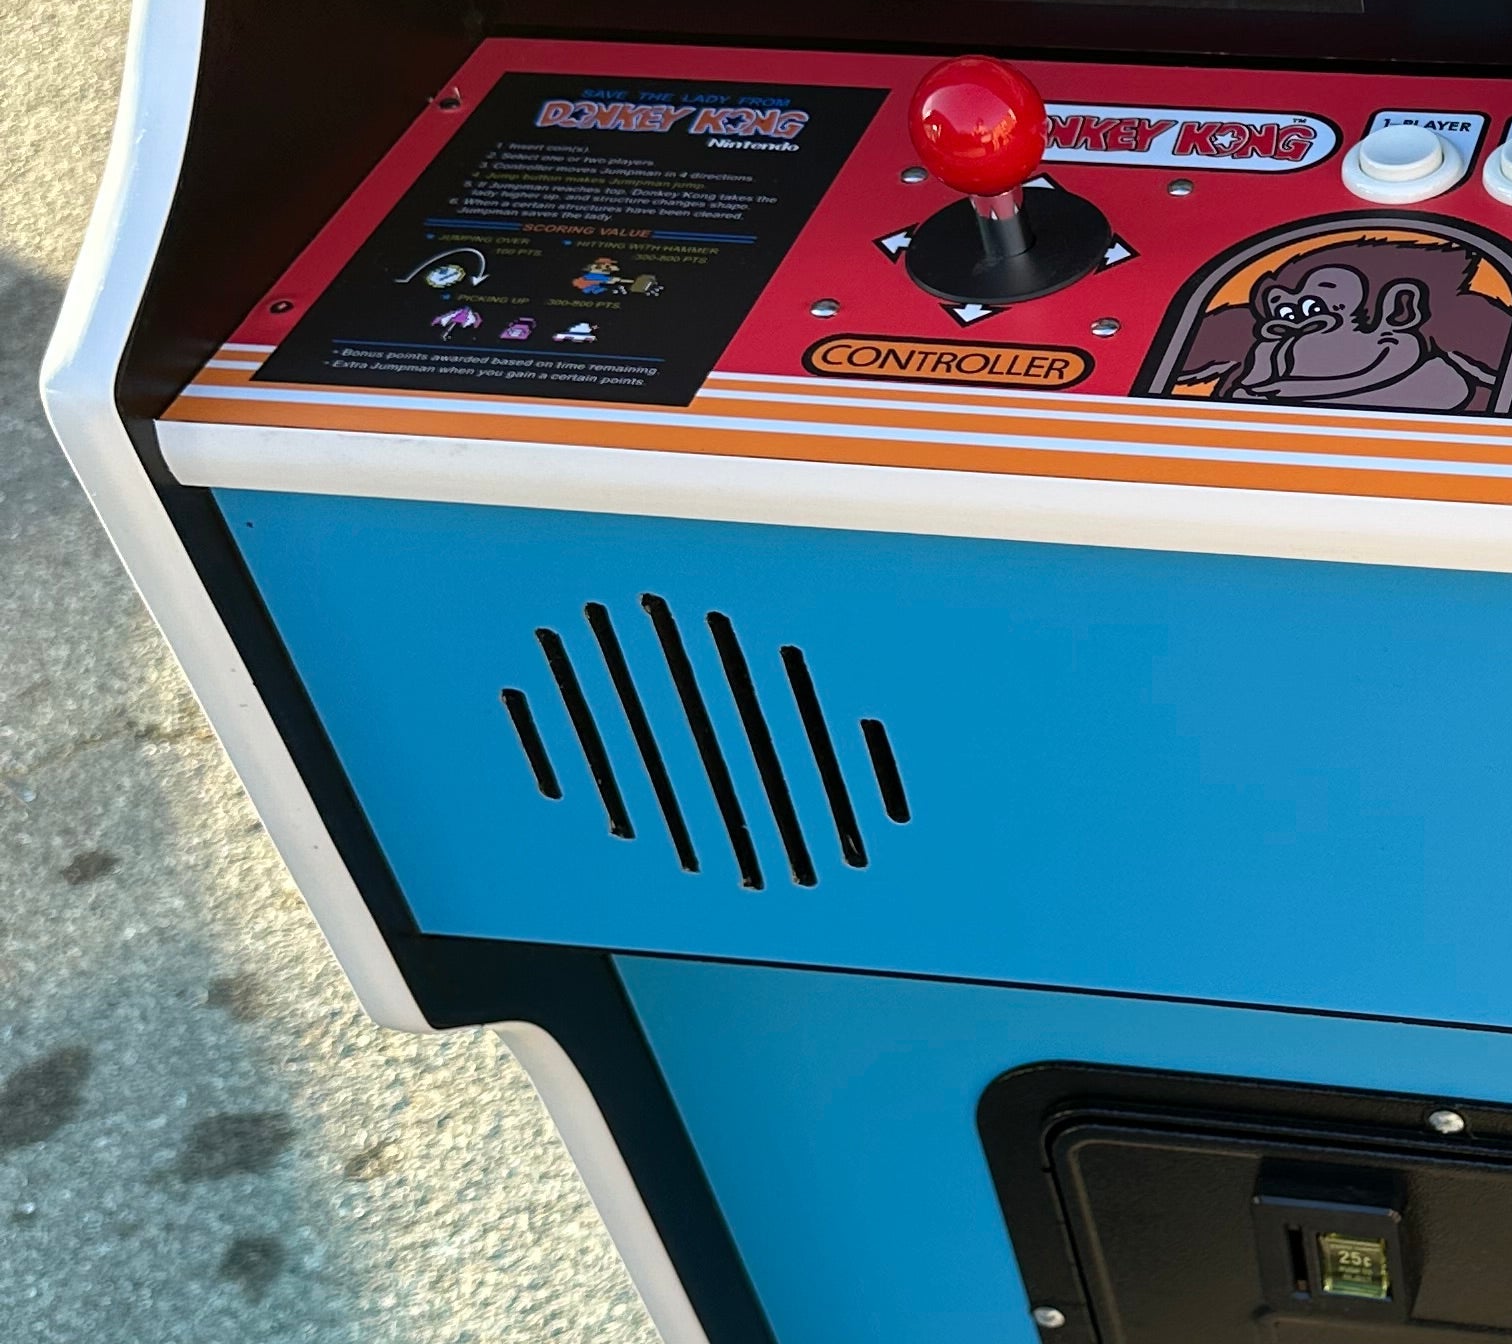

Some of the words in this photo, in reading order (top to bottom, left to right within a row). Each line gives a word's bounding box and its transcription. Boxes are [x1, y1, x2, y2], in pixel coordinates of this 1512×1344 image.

[582, 88, 627, 99] SAVE
[639, 91, 676, 102] THE
[682, 93, 729, 104] LADY
[738, 96, 791, 107] FROM
[535, 100, 696, 132] DONKEY
[688, 107, 810, 139] KONG
[707, 138, 800, 152] Nintendo
[1046, 114, 1180, 152] NKEY
[1172, 121, 1318, 162] KONG
[508, 142, 545, 152] Insert
[501, 151, 540, 161] Select
[541, 154, 565, 162] one
[567, 155, 581, 163] or
[583, 156, 607, 165] two
[493, 162, 553, 171] Controller
[556, 165, 598, 174] moves
[600, 167, 663, 177] Jumpman
[664, 170, 677, 178] in
[679, 171, 688, 179] 4
[484, 172, 521, 181] Jump
[522, 173, 562, 182] button
[565, 175, 606, 184] makes
[607, 178, 671, 188] Jumpman
[471, 188, 499, 198] lady
[500, 190, 541, 200] higher
[565, 194, 591, 202] and
[593, 195, 651, 205] structure
[652, 198, 706, 208] changes
[488, 181, 550, 192] Jumpman
[551, 185, 601, 194] reaches
[631, 188, 680, 199] Donkey
[682, 191, 717, 201] Kong
[719, 193, 754, 202] takes
[756, 195, 778, 204] the
[456, 207, 519, 217] Jumpman
[521, 210, 559, 218] saves
[561, 211, 583, 219] the
[463, 197, 500, 207] When
[511, 200, 556, 209] certain
[557, 203, 623, 213] structures
[625, 206, 657, 216] have
[658, 208, 691, 218] been
[521, 223, 596, 235] SCORING
[600, 227, 653, 238] VALUE
[438, 234, 493, 244] JUMPING
[496, 236, 531, 245] OVER
[495, 248, 516, 256] 100
[576, 241, 626, 250] HITTING
[629, 243, 663, 252] WITH
[663, 245, 720, 255] HAMMER
[457, 294, 509, 304] PICKING
[511, 296, 530, 305] UP
[341, 347, 384, 358] Bonus
[385, 351, 428, 361] points
[430, 354, 490, 364] awarded
[490, 356, 534, 367] based
[535, 360, 554, 369] on
[556, 361, 586, 370] time
[821, 344, 1071, 380] CONTROLLER
[331, 359, 368, 369] Extra
[369, 362, 436, 372] Jumpman
[438, 366, 475, 375] when
[475, 368, 504, 378] you
[504, 370, 537, 380] gain
[538, 372, 548, 380] a
[550, 372, 598, 383] certain
